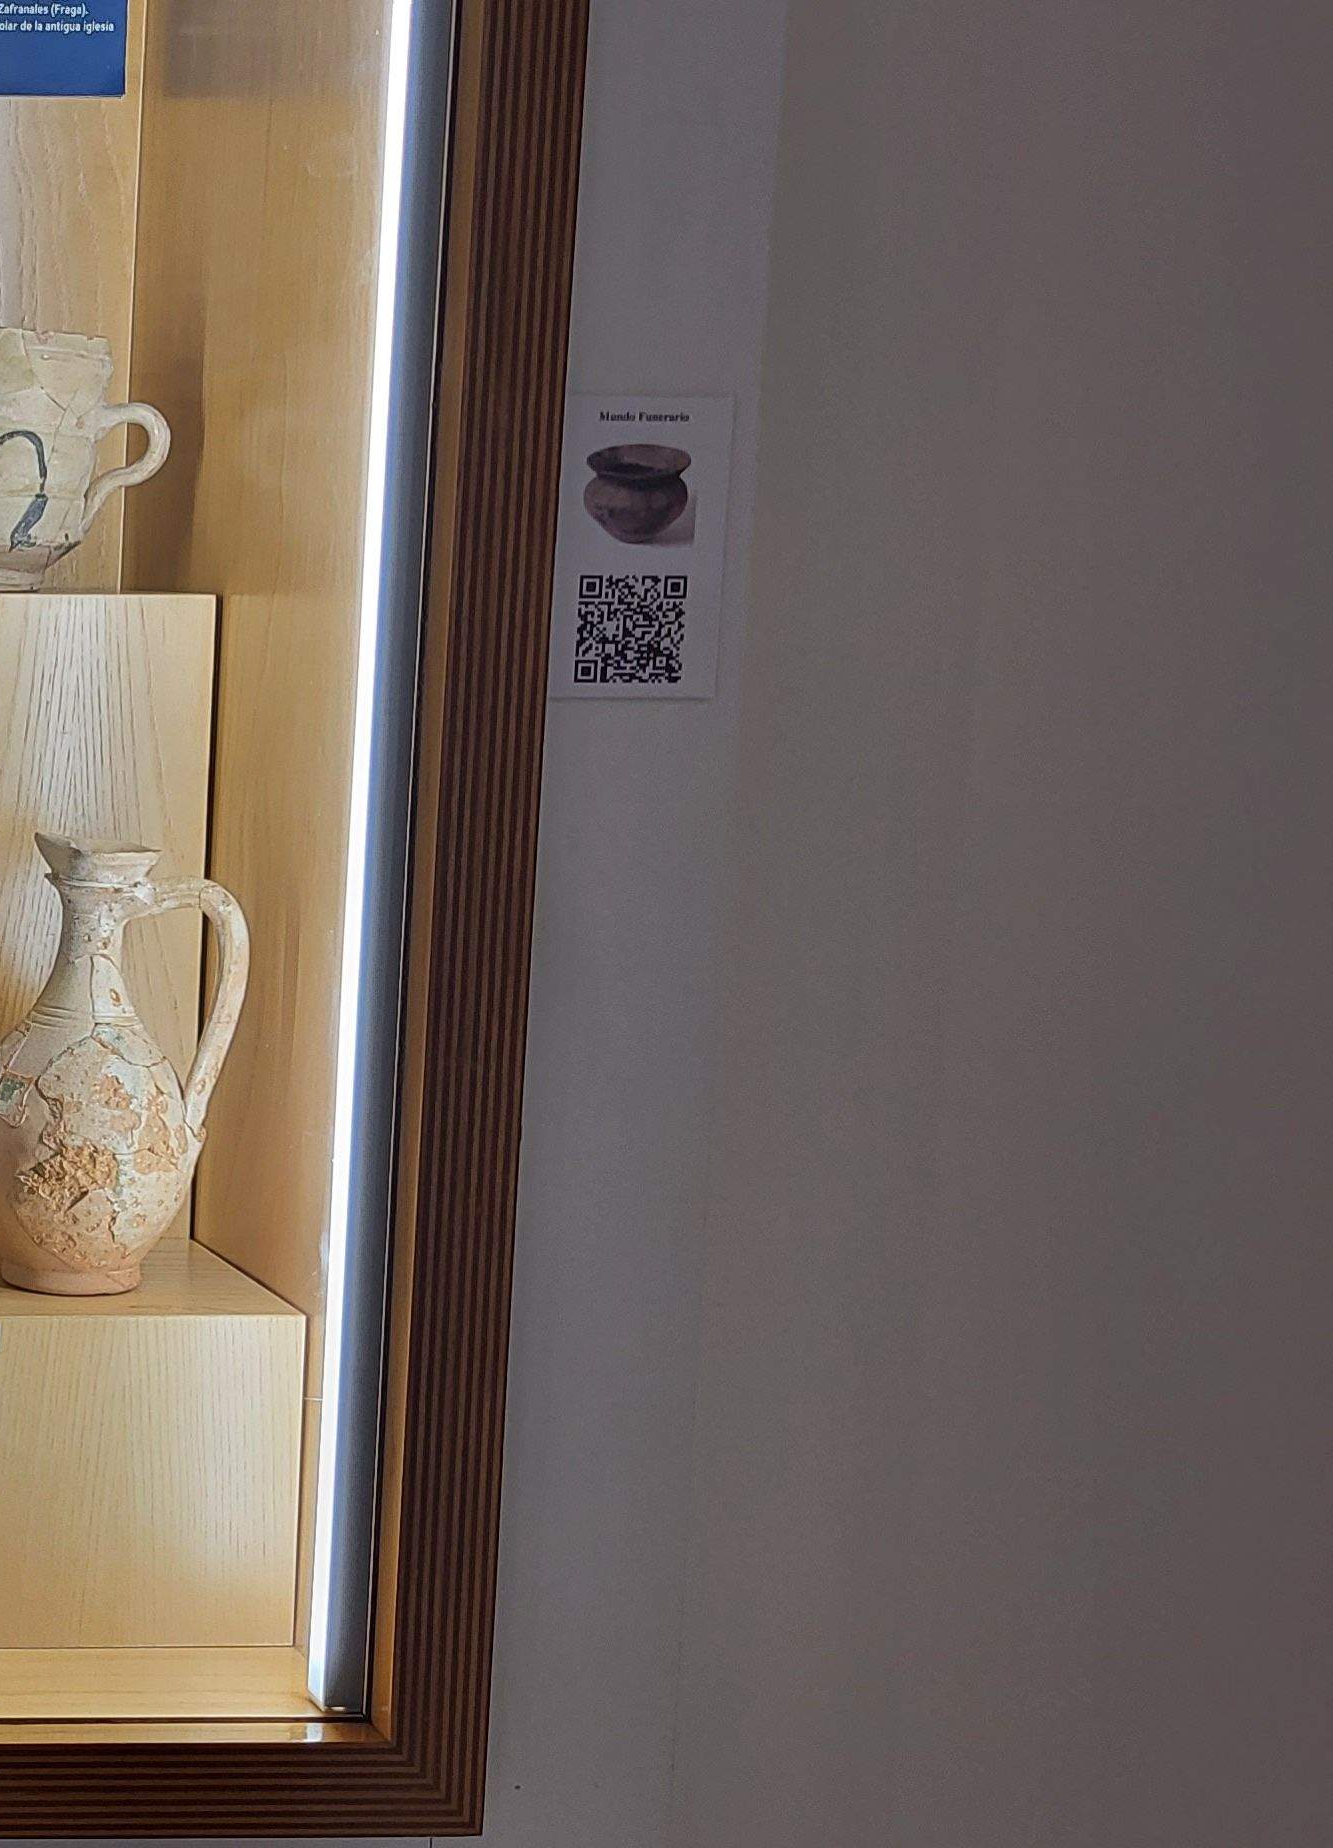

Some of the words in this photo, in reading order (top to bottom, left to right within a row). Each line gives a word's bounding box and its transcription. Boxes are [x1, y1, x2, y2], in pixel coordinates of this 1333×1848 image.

[51, 4, 89, 17] (Fraga).
[20, 21, 33, 31] de
[35, 20, 43, 31] la
[45, 21, 81, 34] antigua
[84, 20, 114, 34] iglesia
[600, 411, 635, 421] Mundo
[639, 411, 690, 421] Funerario
